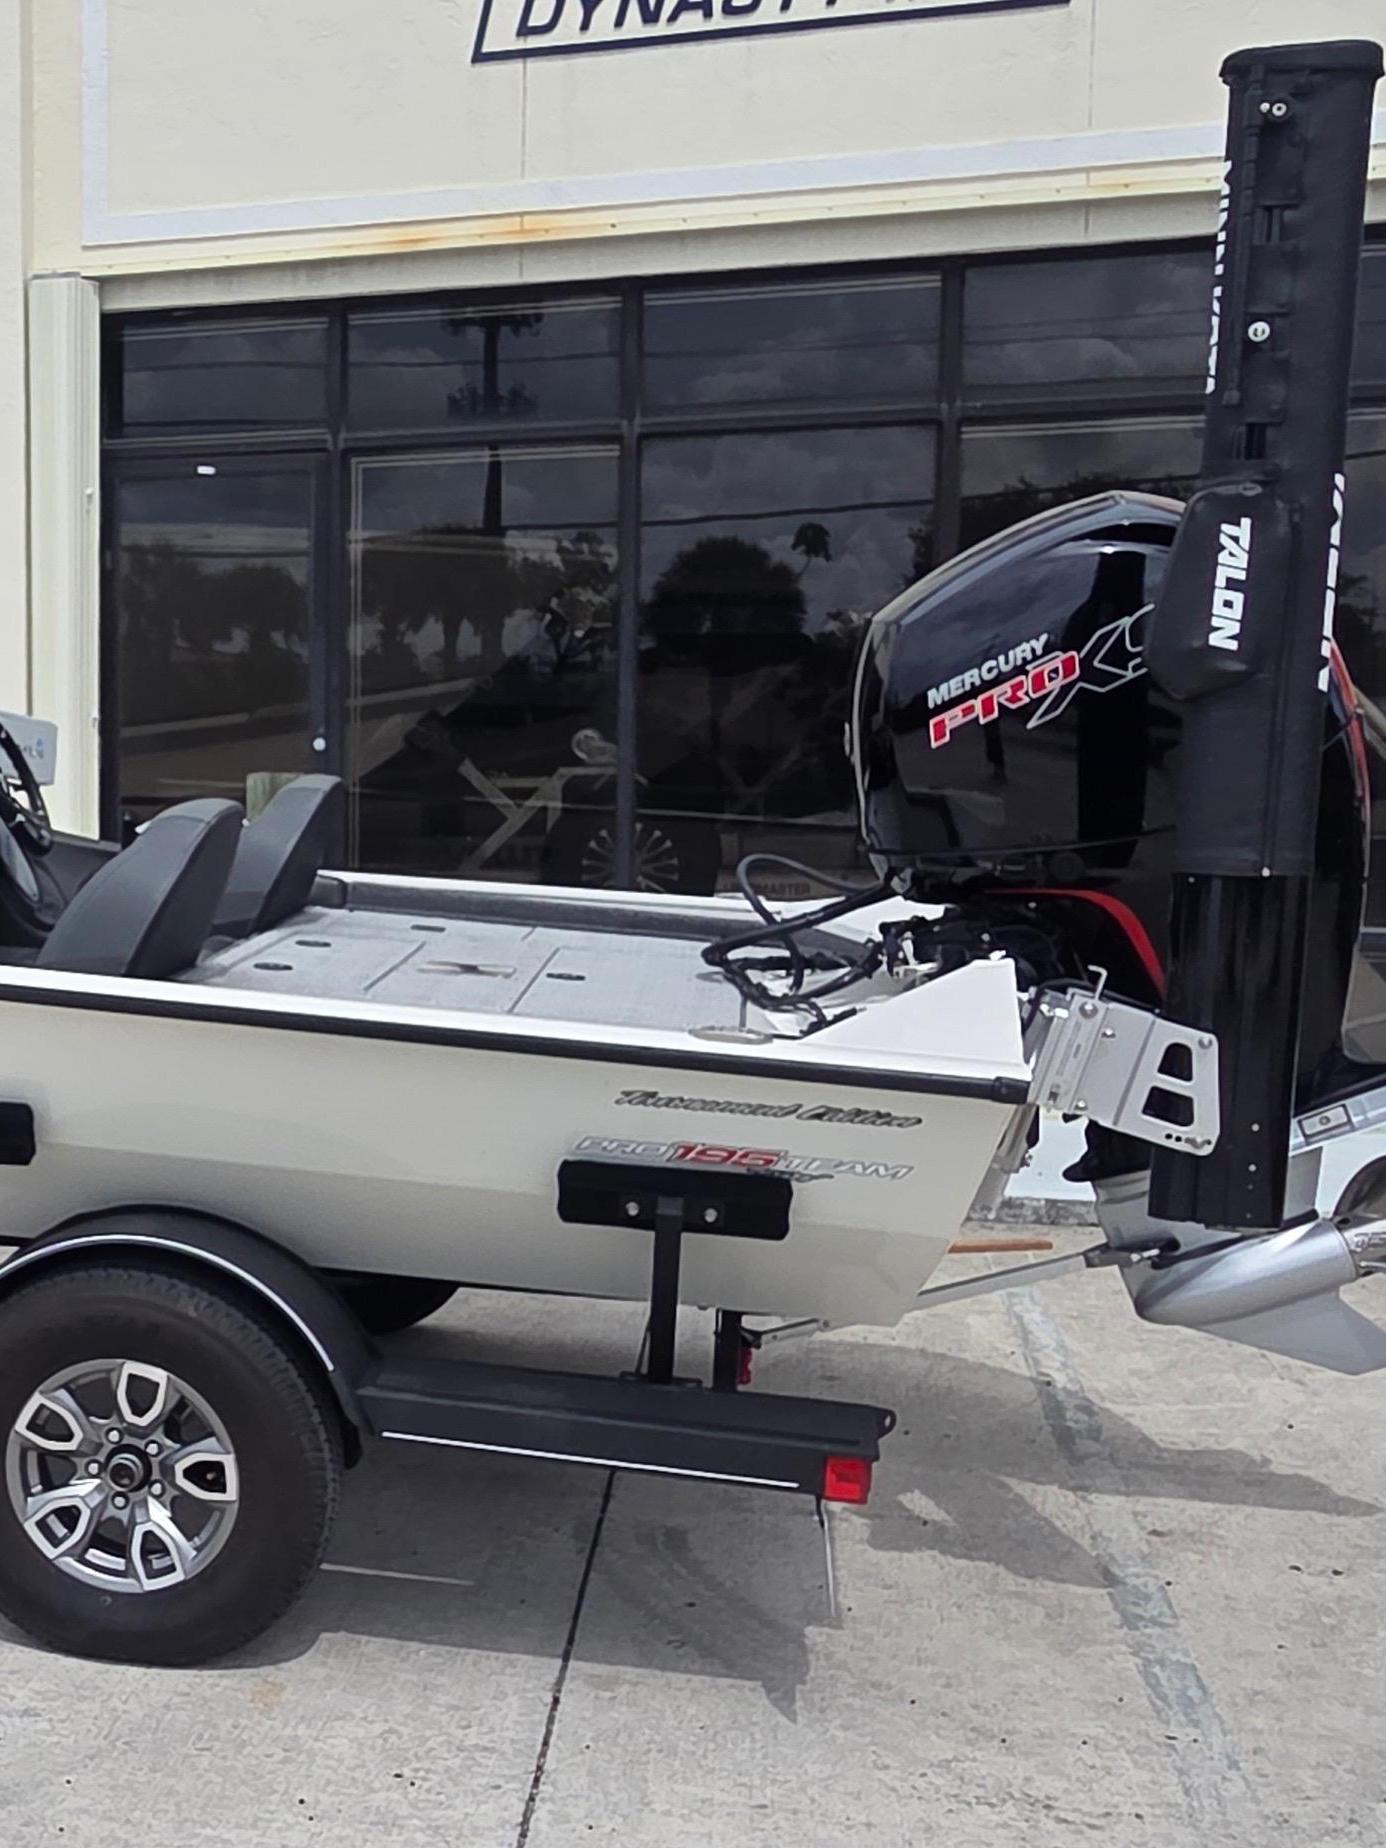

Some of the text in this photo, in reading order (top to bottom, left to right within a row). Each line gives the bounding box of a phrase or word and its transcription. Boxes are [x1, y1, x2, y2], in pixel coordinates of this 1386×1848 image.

[516, 0, 836, 37] DYNA
[1208, 517, 1252, 651] TALON
[927, 633, 1049, 709] MERCURY
[929, 650, 1080, 749] PRO
